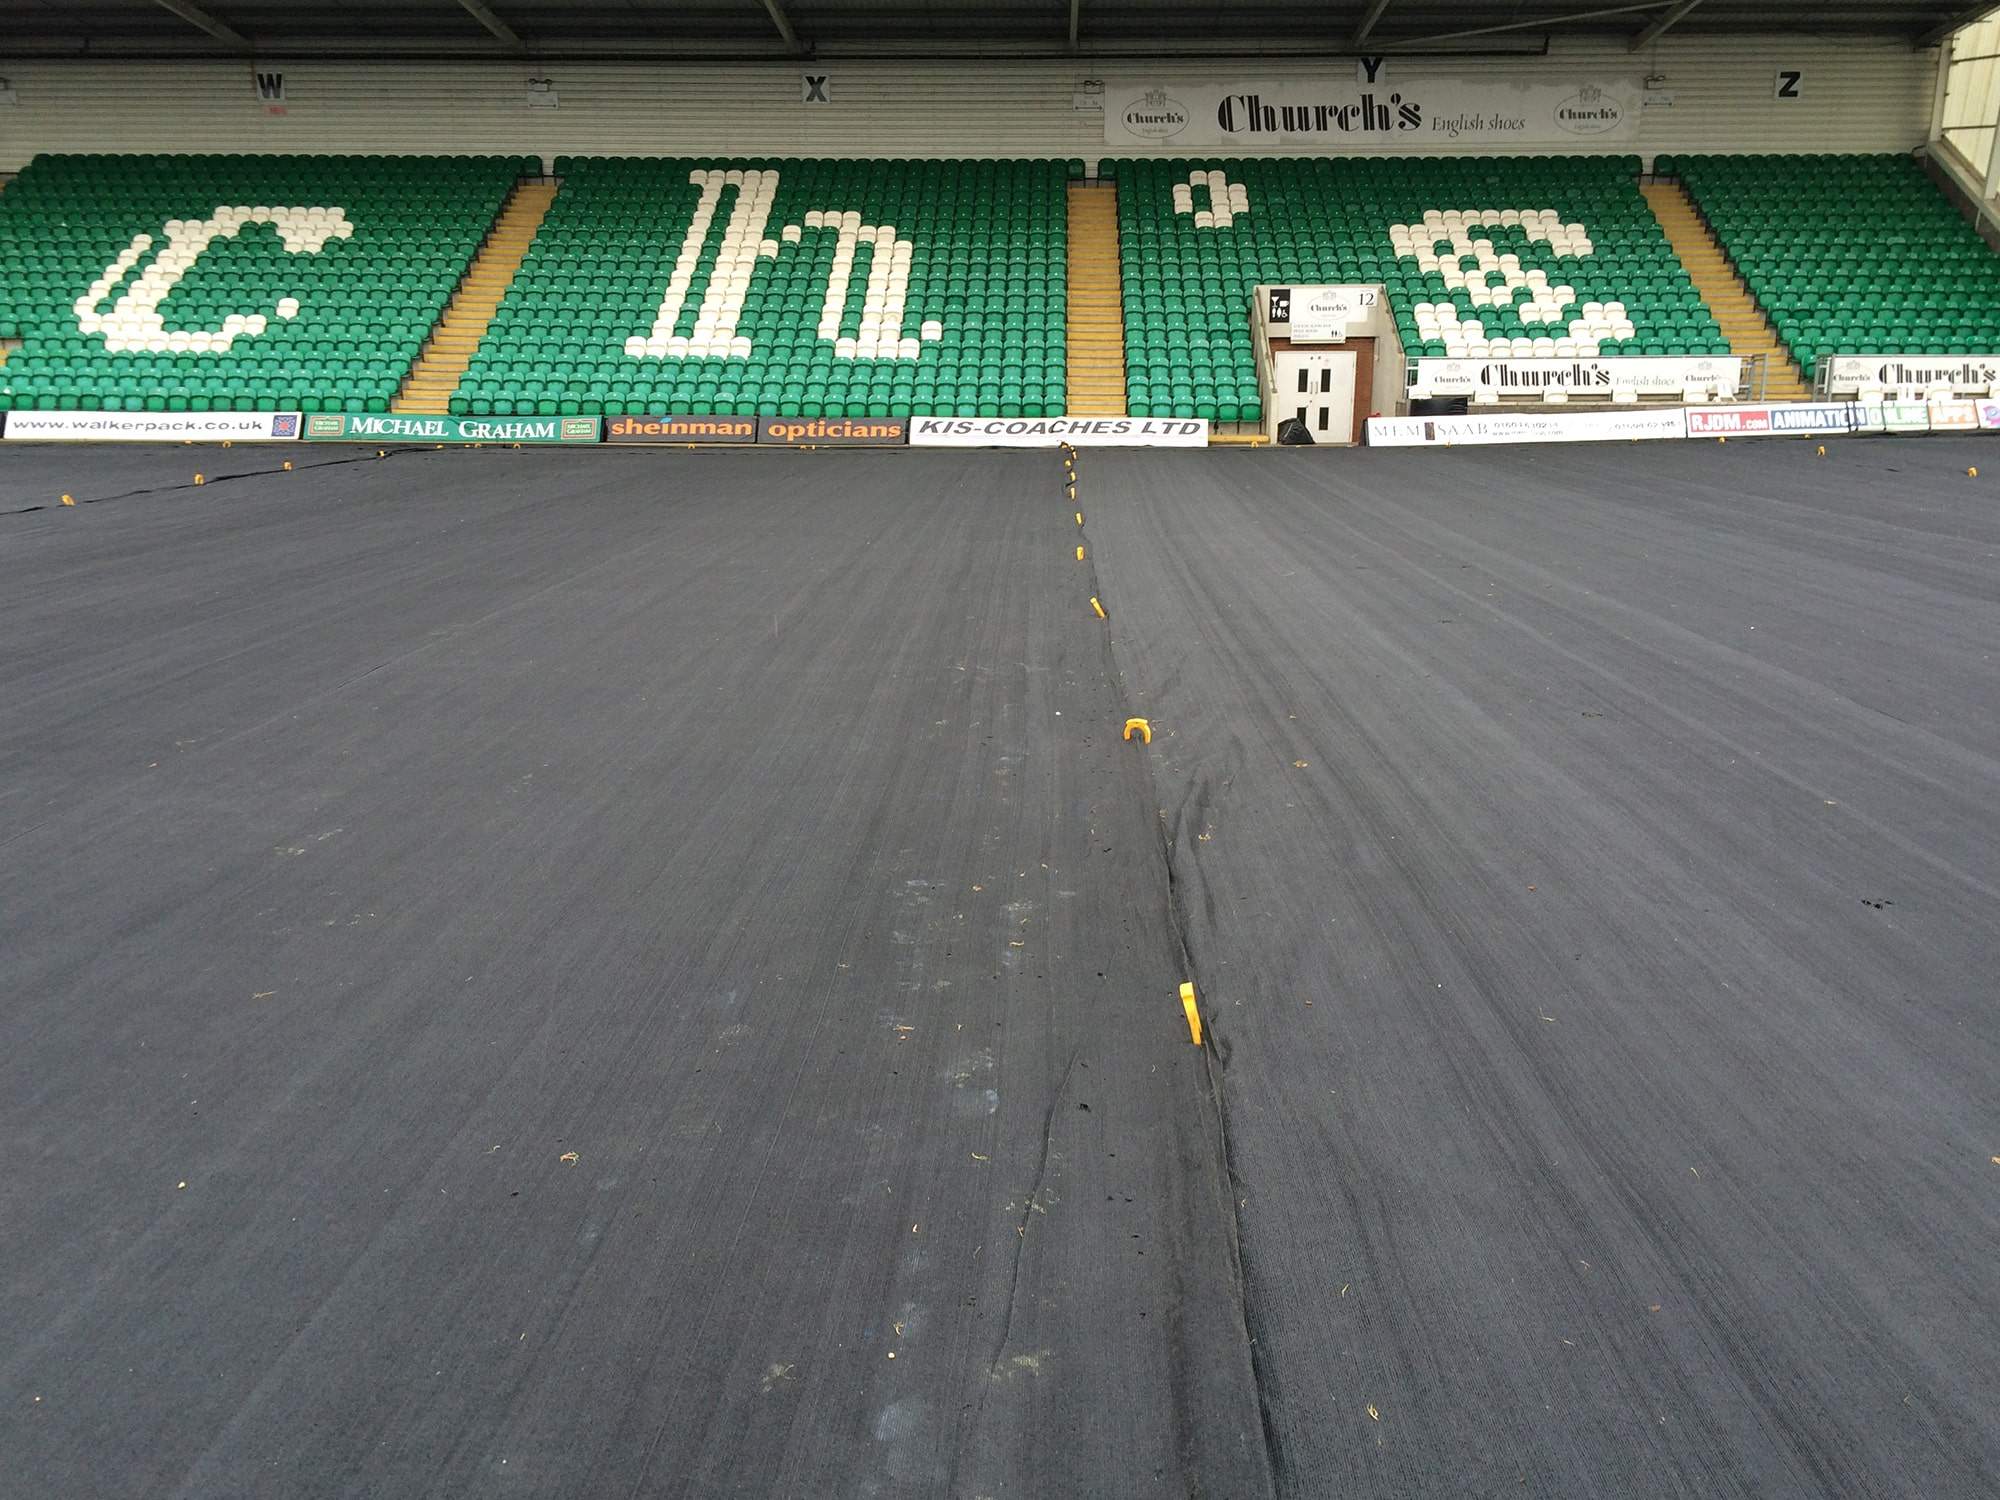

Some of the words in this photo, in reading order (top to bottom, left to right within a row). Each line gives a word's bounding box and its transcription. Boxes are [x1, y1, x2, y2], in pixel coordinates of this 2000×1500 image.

[1360, 57, 1383, 84] Y
[257, 73, 282, 99] W
[805, 75, 828, 102] X
[1778, 71, 1801, 98] Z
[1126, 112, 1184, 124] Church's
[1217, 92, 1422, 134] Church's
[1432, 113, 1484, 137] English
[1487, 113, 1526, 131] shoes
[1559, 107, 1618, 120] Church's
[1360, 293, 1374, 306] 12
[1480, 363, 1611, 387] Church's
[1878, 363, 1997, 384] Church's
[13, 419, 263, 431] www.walkerpack.co.uk
[350, 416, 448, 436] MICHAEL
[459, 421, 555, 439] GRAHAM
[611, 417, 752, 436] sheinman
[768, 420, 902, 442] opticians
[919, 420, 1132, 435] KIS-COACHES
[1140, 421, 1201, 435] LTD
